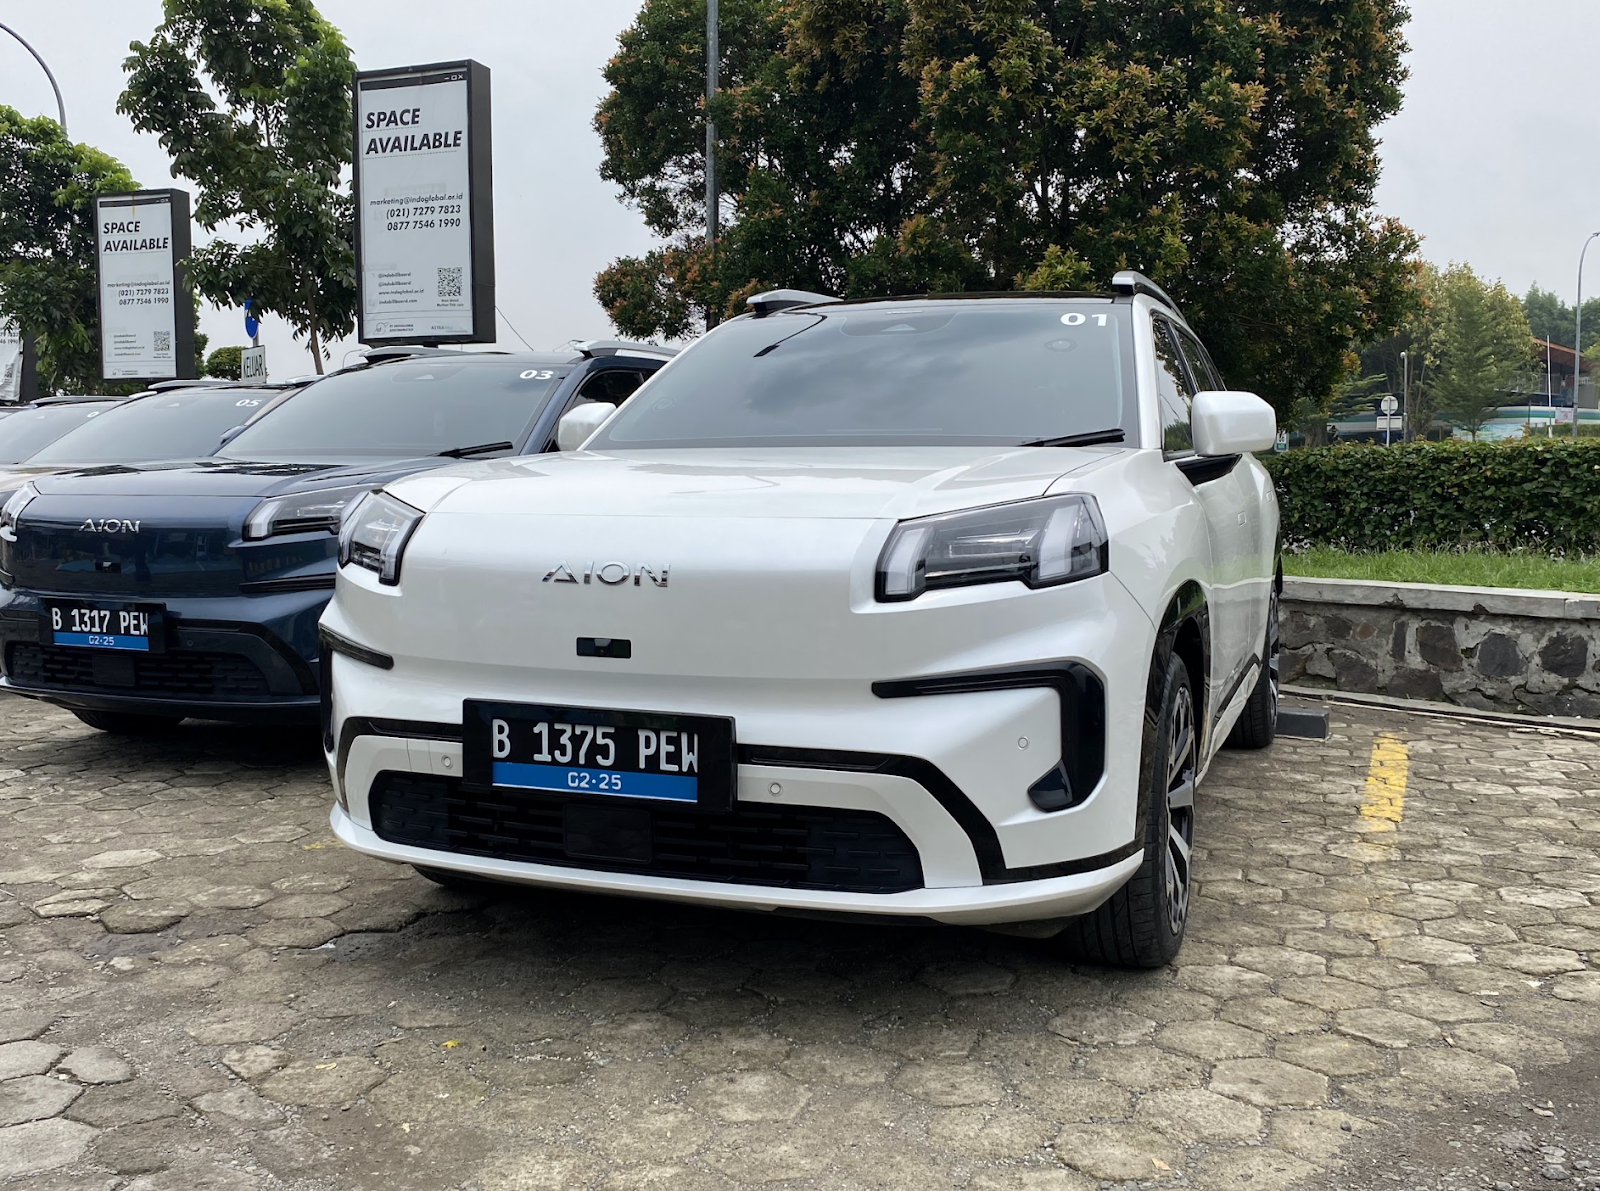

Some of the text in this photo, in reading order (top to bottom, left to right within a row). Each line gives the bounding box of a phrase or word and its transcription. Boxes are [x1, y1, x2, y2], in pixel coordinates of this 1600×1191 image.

[366, 108, 420, 129] SPACE
[366, 131, 462, 155] AVAILABLE
[370, 193, 463, 206] marketing@indoglobal.or.id
[386, 205, 461, 220] (021) 7279 7823
[103, 221, 140, 234] SPACE
[387, 218, 460, 231] 0877 7546 1990
[104, 237, 169, 252] AVAILABLE
[118, 289, 134, 297] (021)
[1060, 312, 1107, 327] 01
[244, 354, 264, 378] KELUAR
[520, 370, 554, 380] 03
[79, 518, 140, 533] AION
[542, 560, 671, 588] AION
[52, 607, 149, 635] B 1317 PEW
[492, 718, 698, 773] B 1375 PEW
